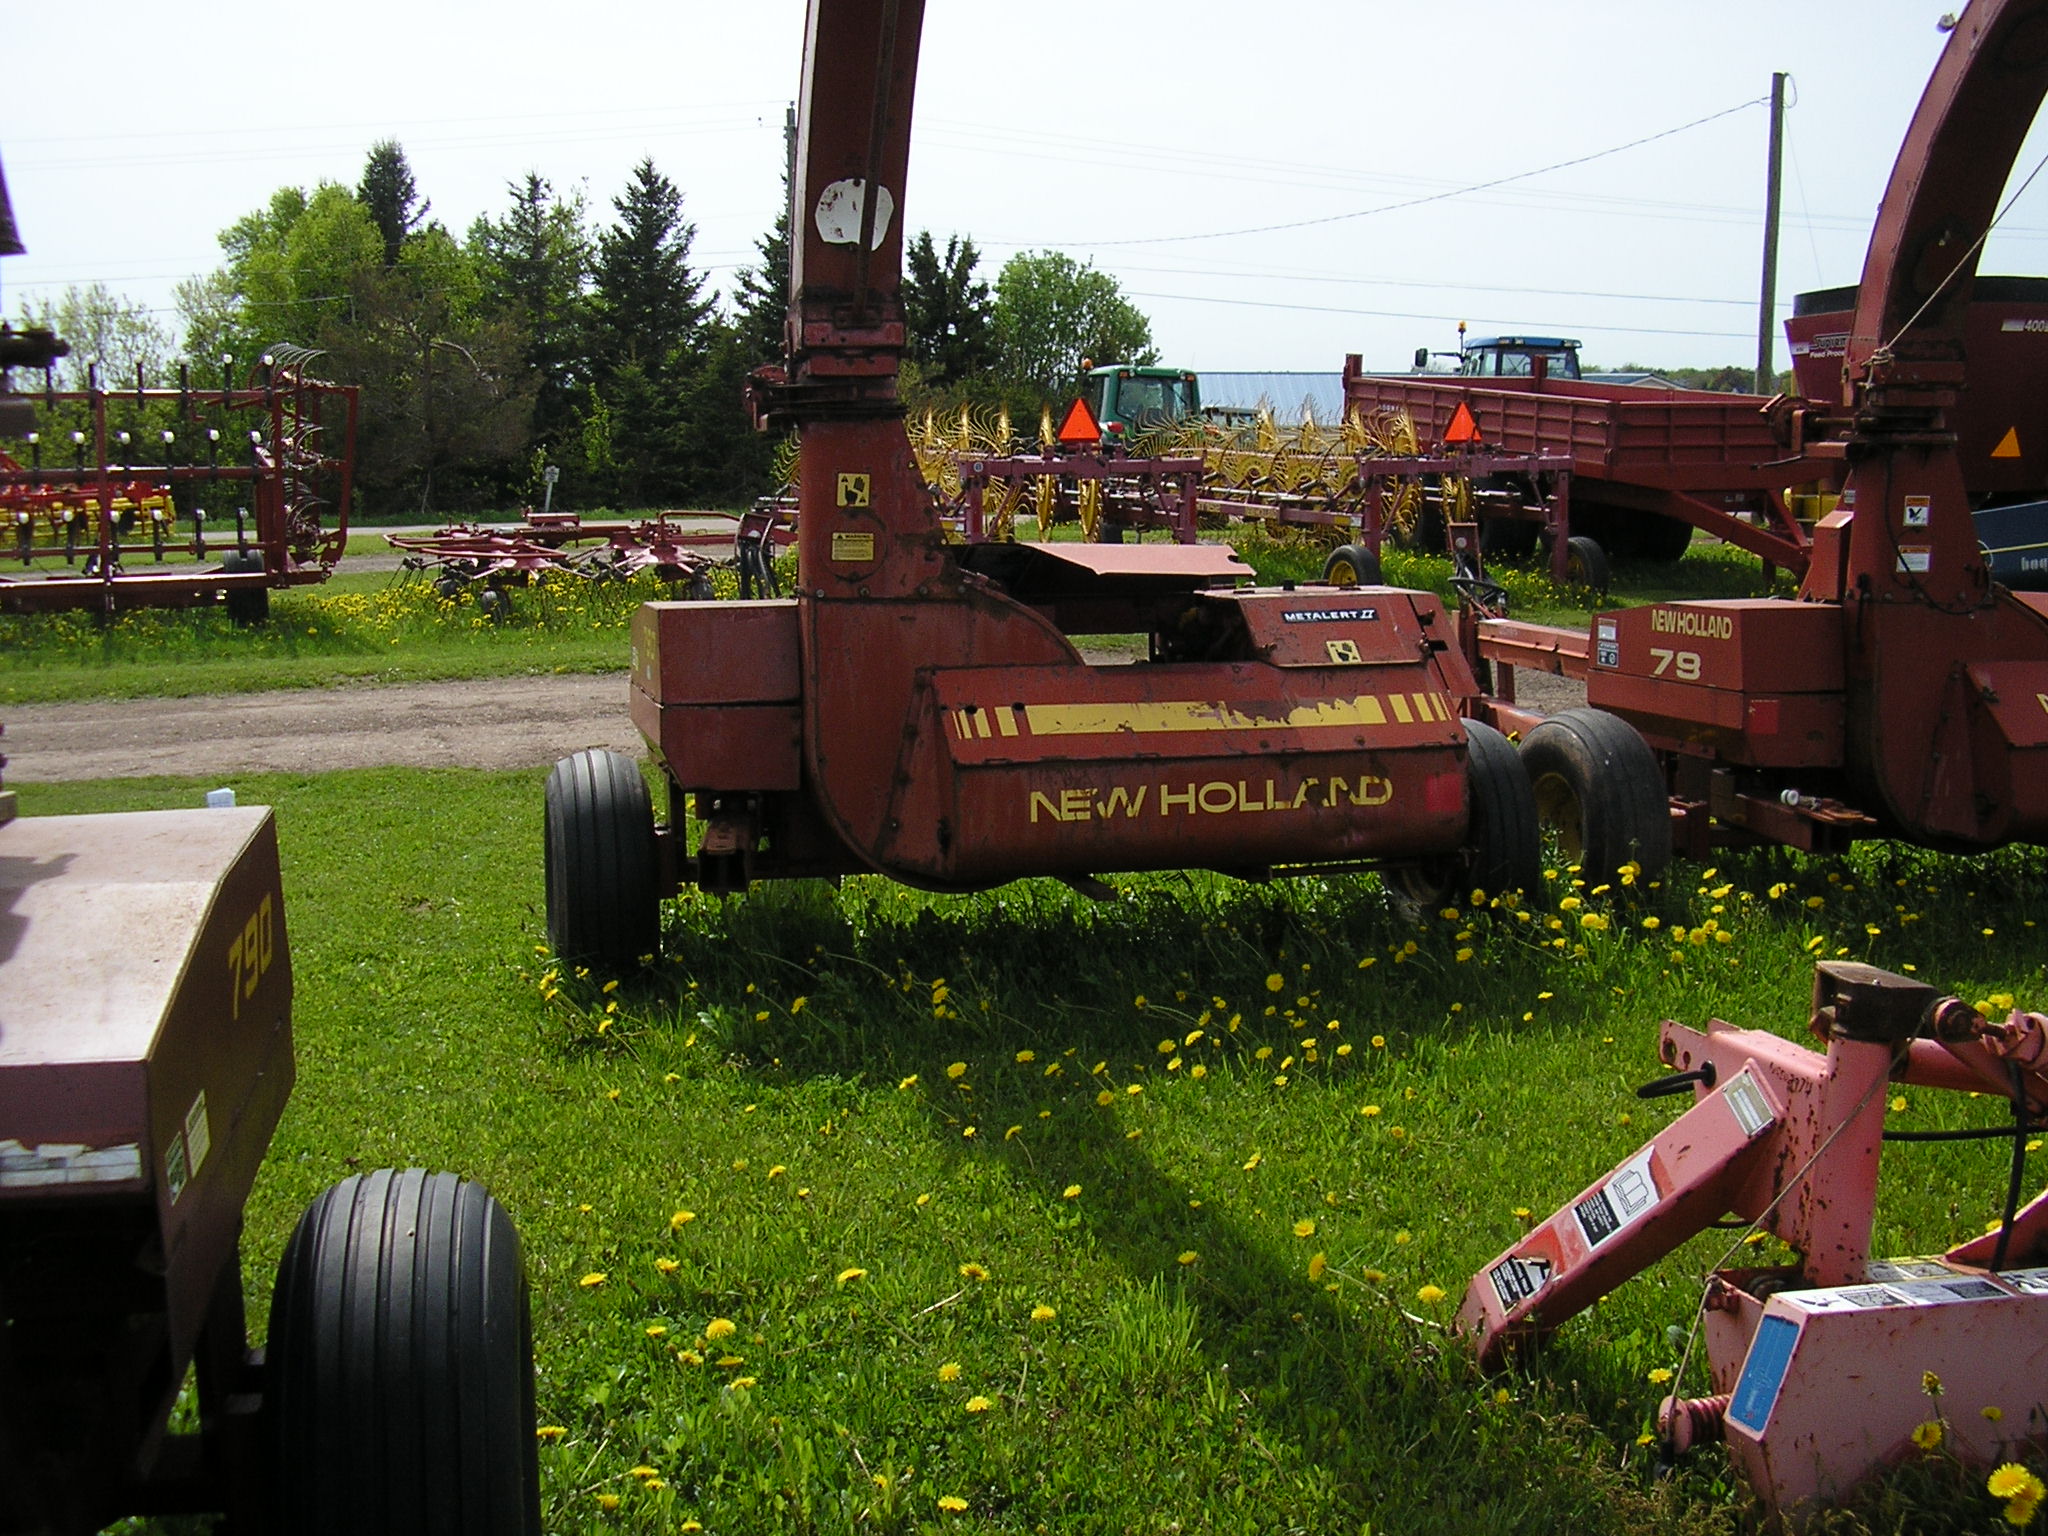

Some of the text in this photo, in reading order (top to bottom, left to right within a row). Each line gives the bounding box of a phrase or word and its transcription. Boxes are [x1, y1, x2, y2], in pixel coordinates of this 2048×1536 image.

[1284, 608, 1375, 621] METALERT II
[1677, 611, 1733, 640] HOLLAND
[1650, 648, 1701, 680] 79
[1029, 775, 1394, 823] NEW HOLLAND
[228, 891, 272, 1021] 790
